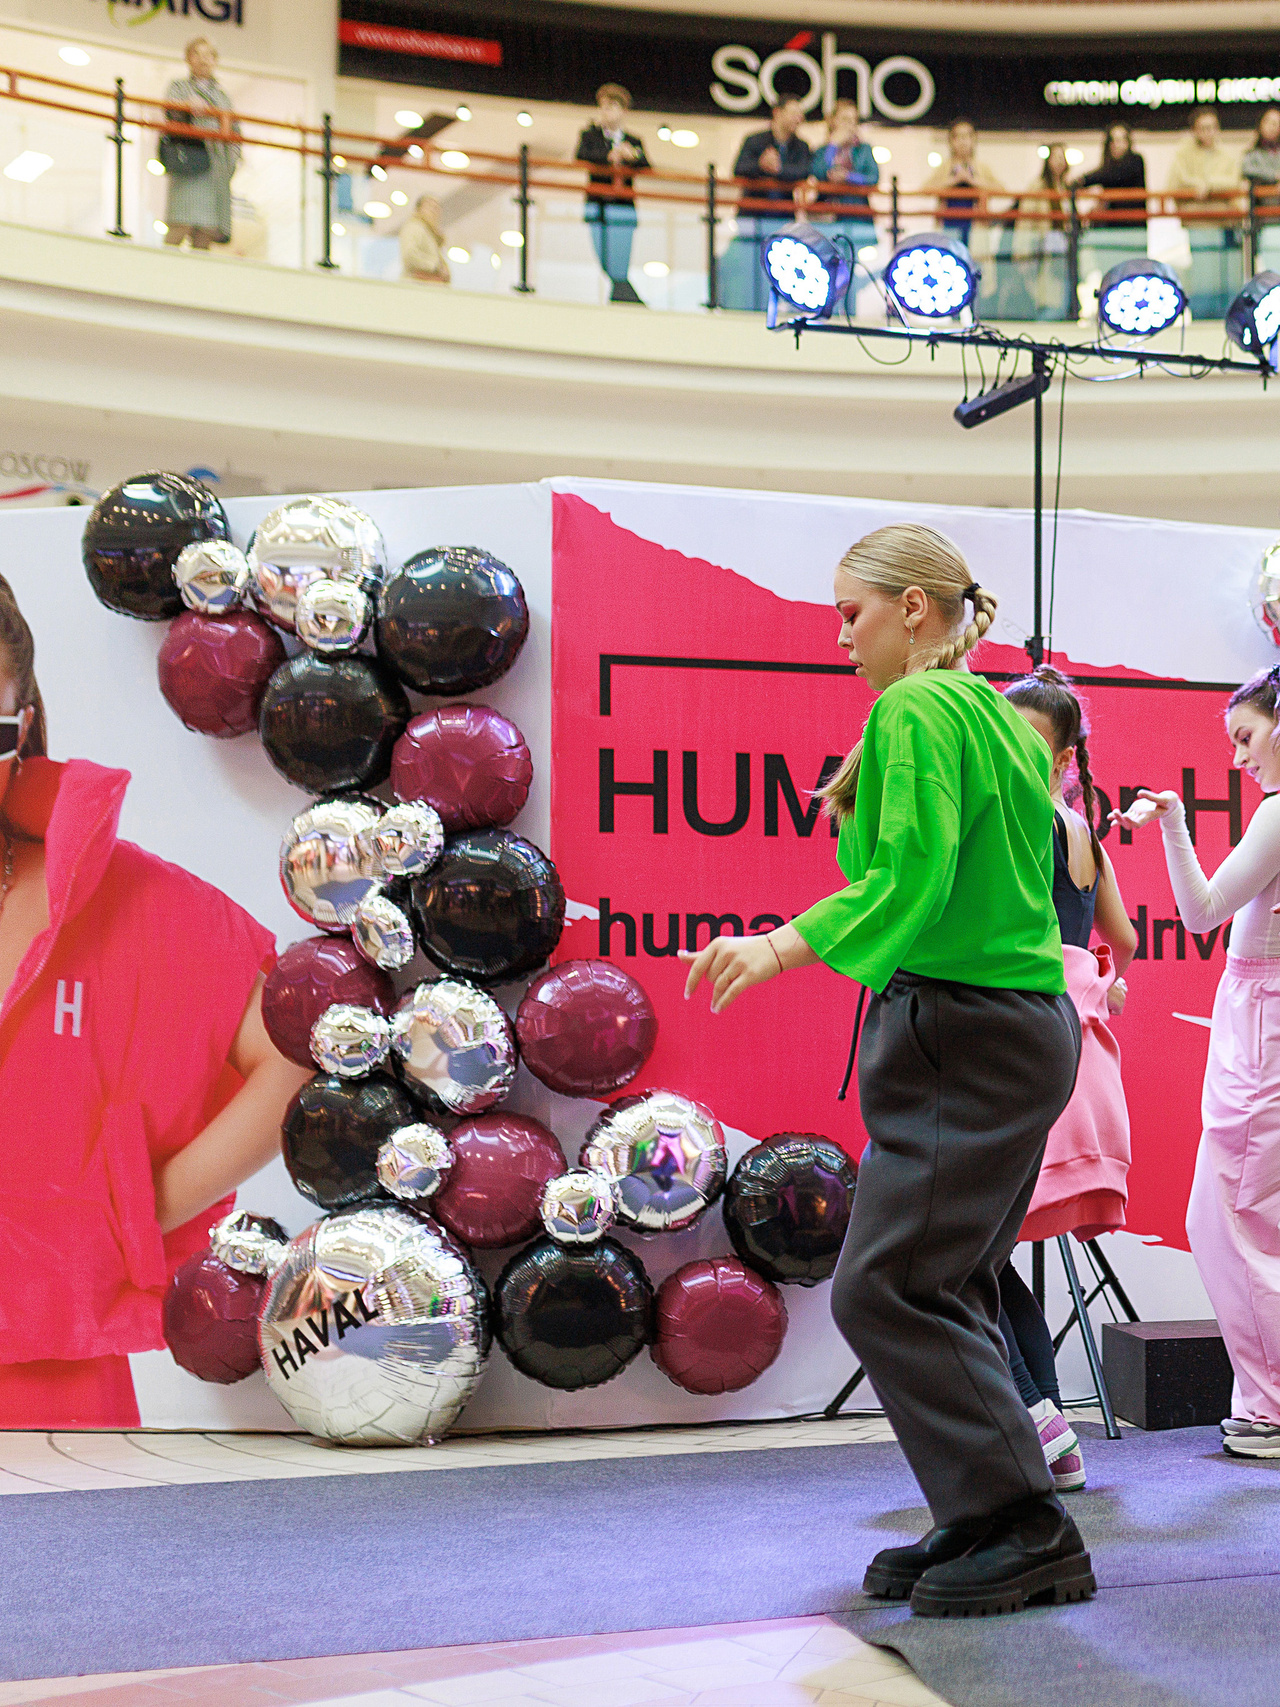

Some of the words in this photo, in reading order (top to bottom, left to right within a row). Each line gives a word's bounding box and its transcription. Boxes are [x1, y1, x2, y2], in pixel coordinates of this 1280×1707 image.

[1044, 80, 1119, 105] салон
[1120, 73, 1195, 109] обуви
[1196, 78, 1216, 103] и
[54, 979, 83, 1037] H
[272, 1288, 379, 1380] HAVAL
